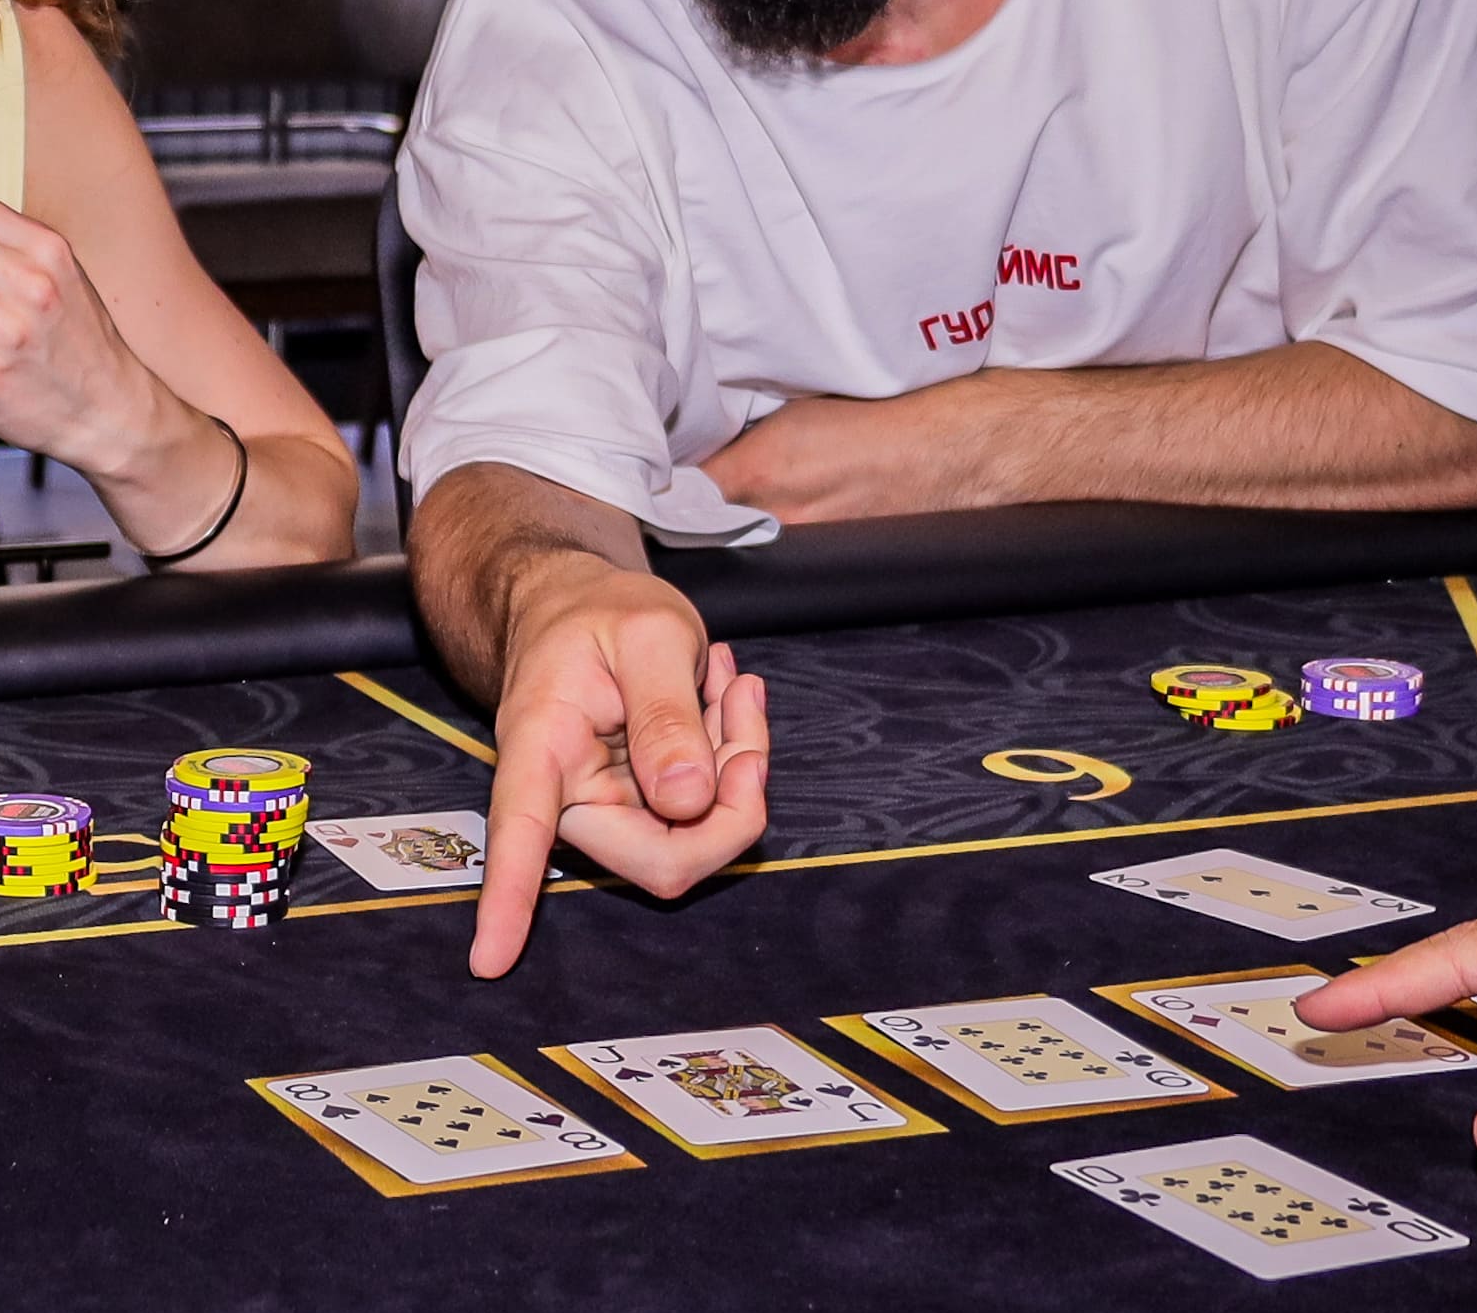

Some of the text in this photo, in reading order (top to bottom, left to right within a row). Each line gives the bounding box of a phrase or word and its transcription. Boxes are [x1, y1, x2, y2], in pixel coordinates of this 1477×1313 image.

[995, 243, 1082, 291] ЙМС
[314, 823, 350, 837] Q
[1103, 873, 1151, 887] 3
[1370, 897, 1421, 912] 3
[590, 1044, 625, 1064] J
[284, 1082, 332, 1102] 8
[846, 1101, 884, 1123] J
[557, 1131, 608, 1151] 8
[1062, 1165, 1125, 1187] 10
[1386, 1217, 1454, 1243] 10
